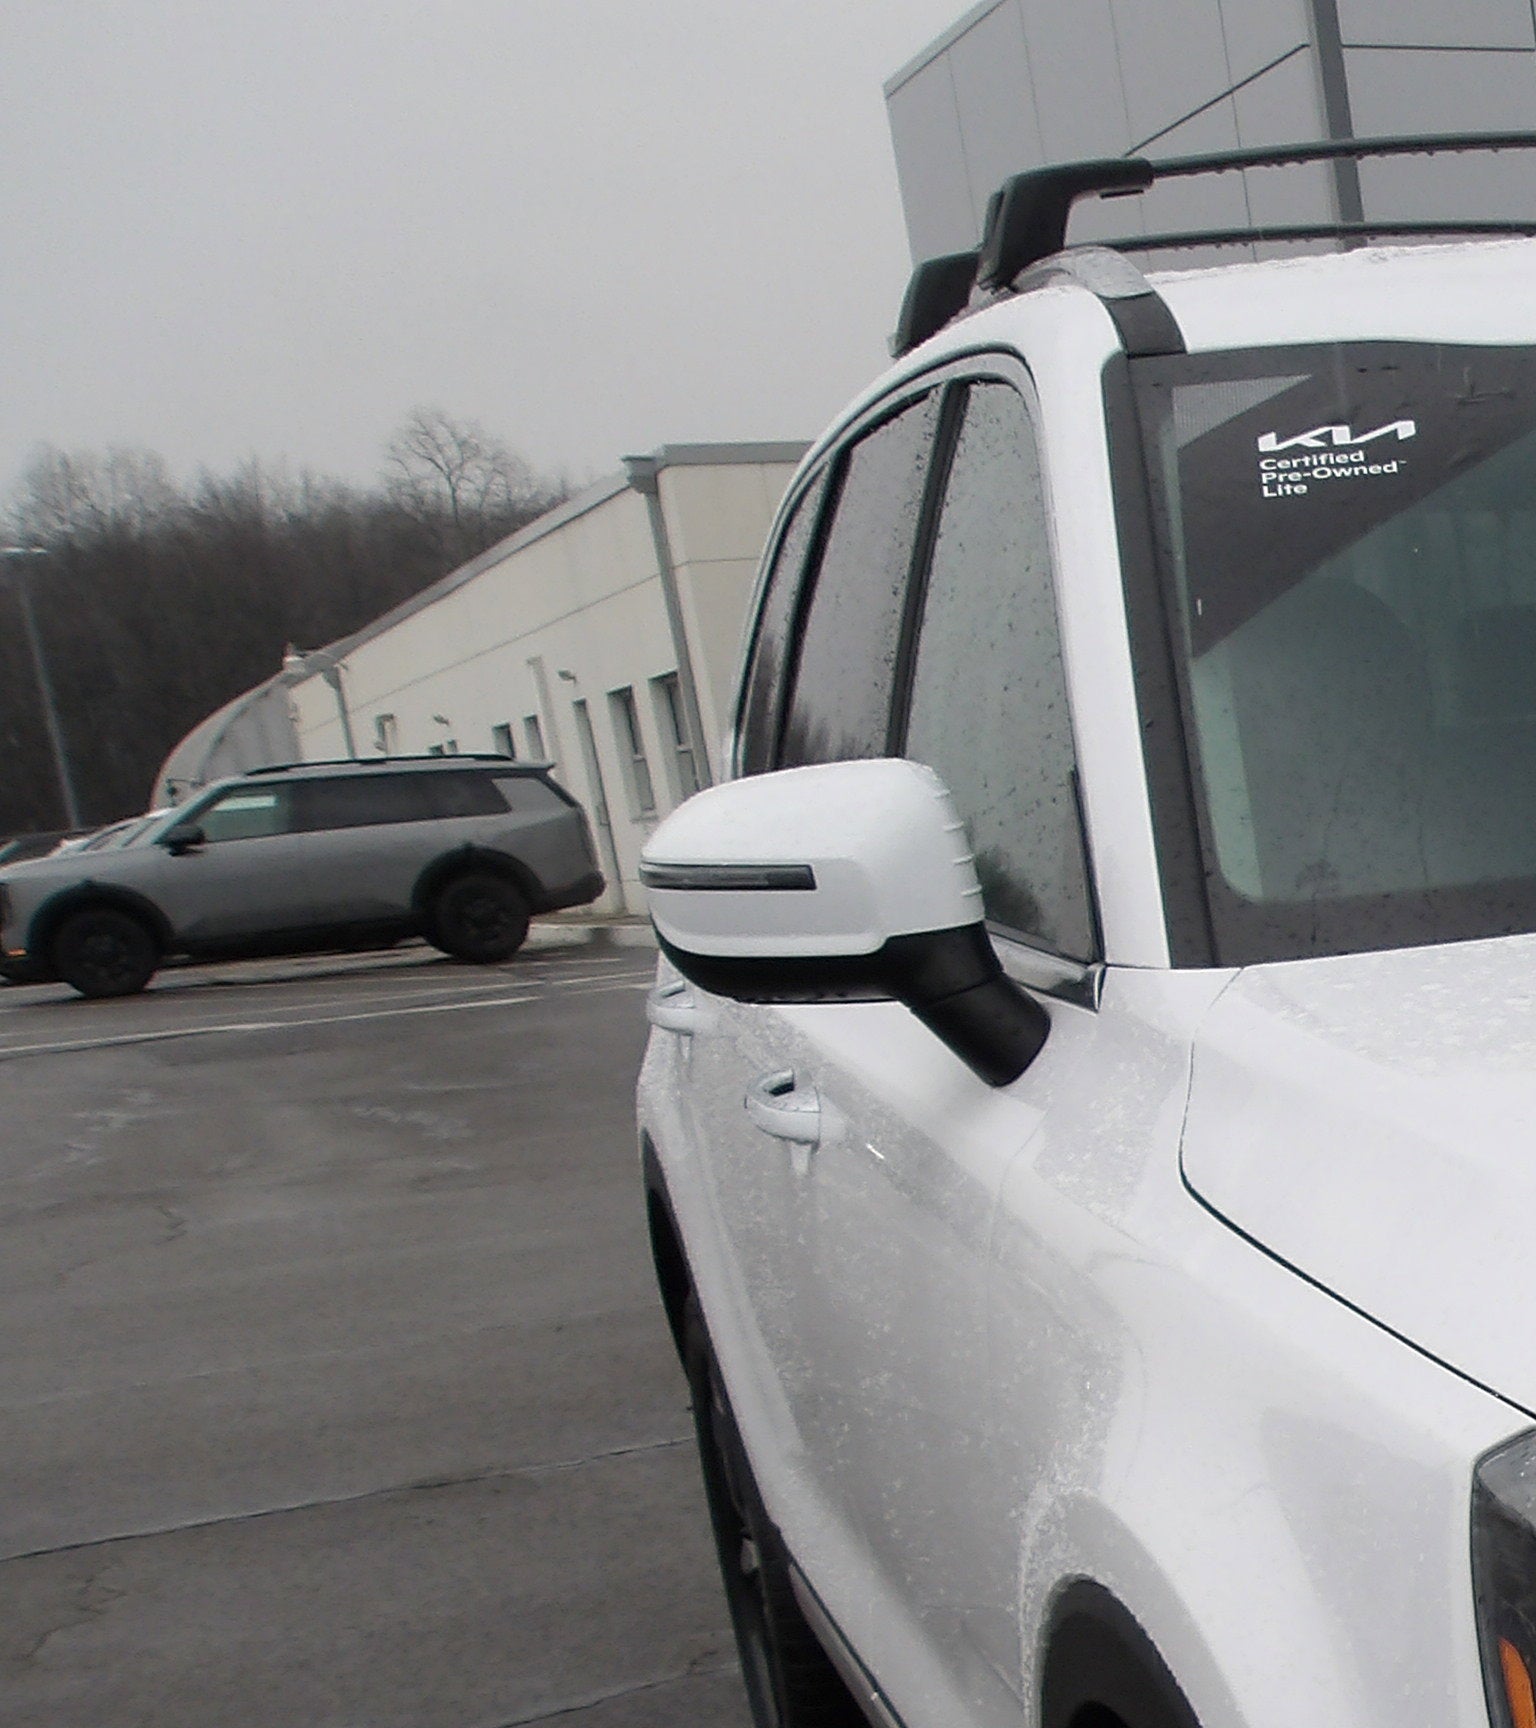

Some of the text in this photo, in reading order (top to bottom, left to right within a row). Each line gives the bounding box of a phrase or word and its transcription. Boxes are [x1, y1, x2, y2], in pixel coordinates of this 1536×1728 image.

[1257, 420, 1416, 452] KIA
[1259, 450, 1365, 471] Certified
[1263, 484, 1308, 498] Lite
